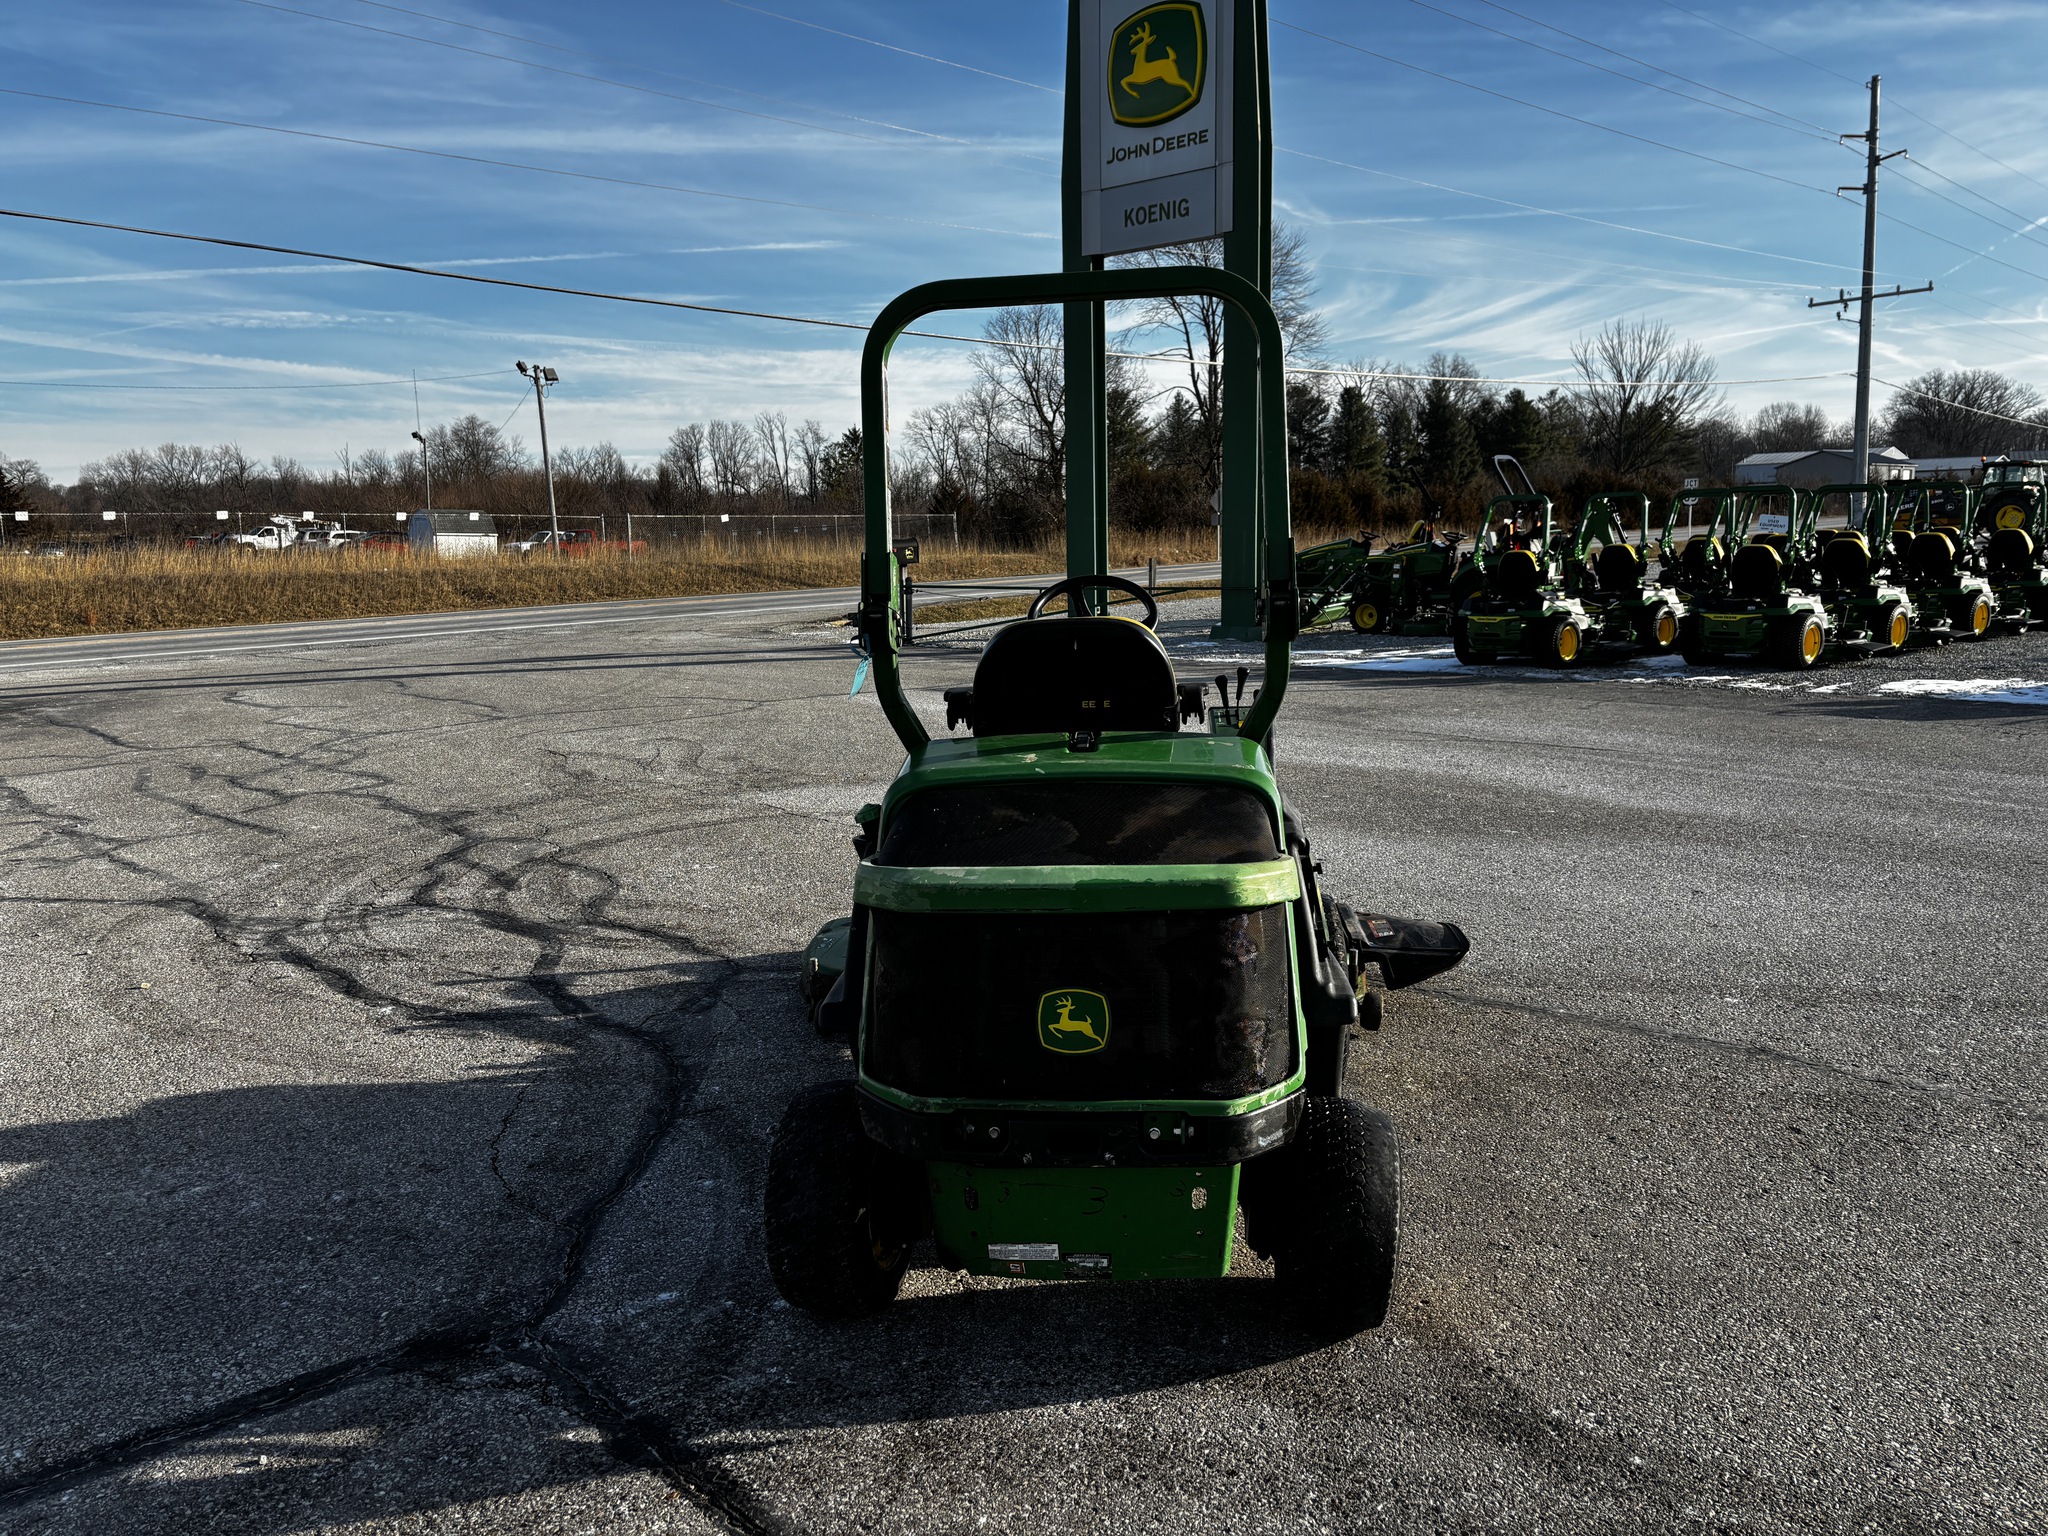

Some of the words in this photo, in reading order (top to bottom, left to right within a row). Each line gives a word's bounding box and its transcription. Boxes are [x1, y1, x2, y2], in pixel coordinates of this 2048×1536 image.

[1106, 142, 1150, 164] JOHN
[1152, 129, 1209, 155] DEERE
[1124, 198, 1190, 228] KOENIG
[1685, 479, 1698, 488] JCT
